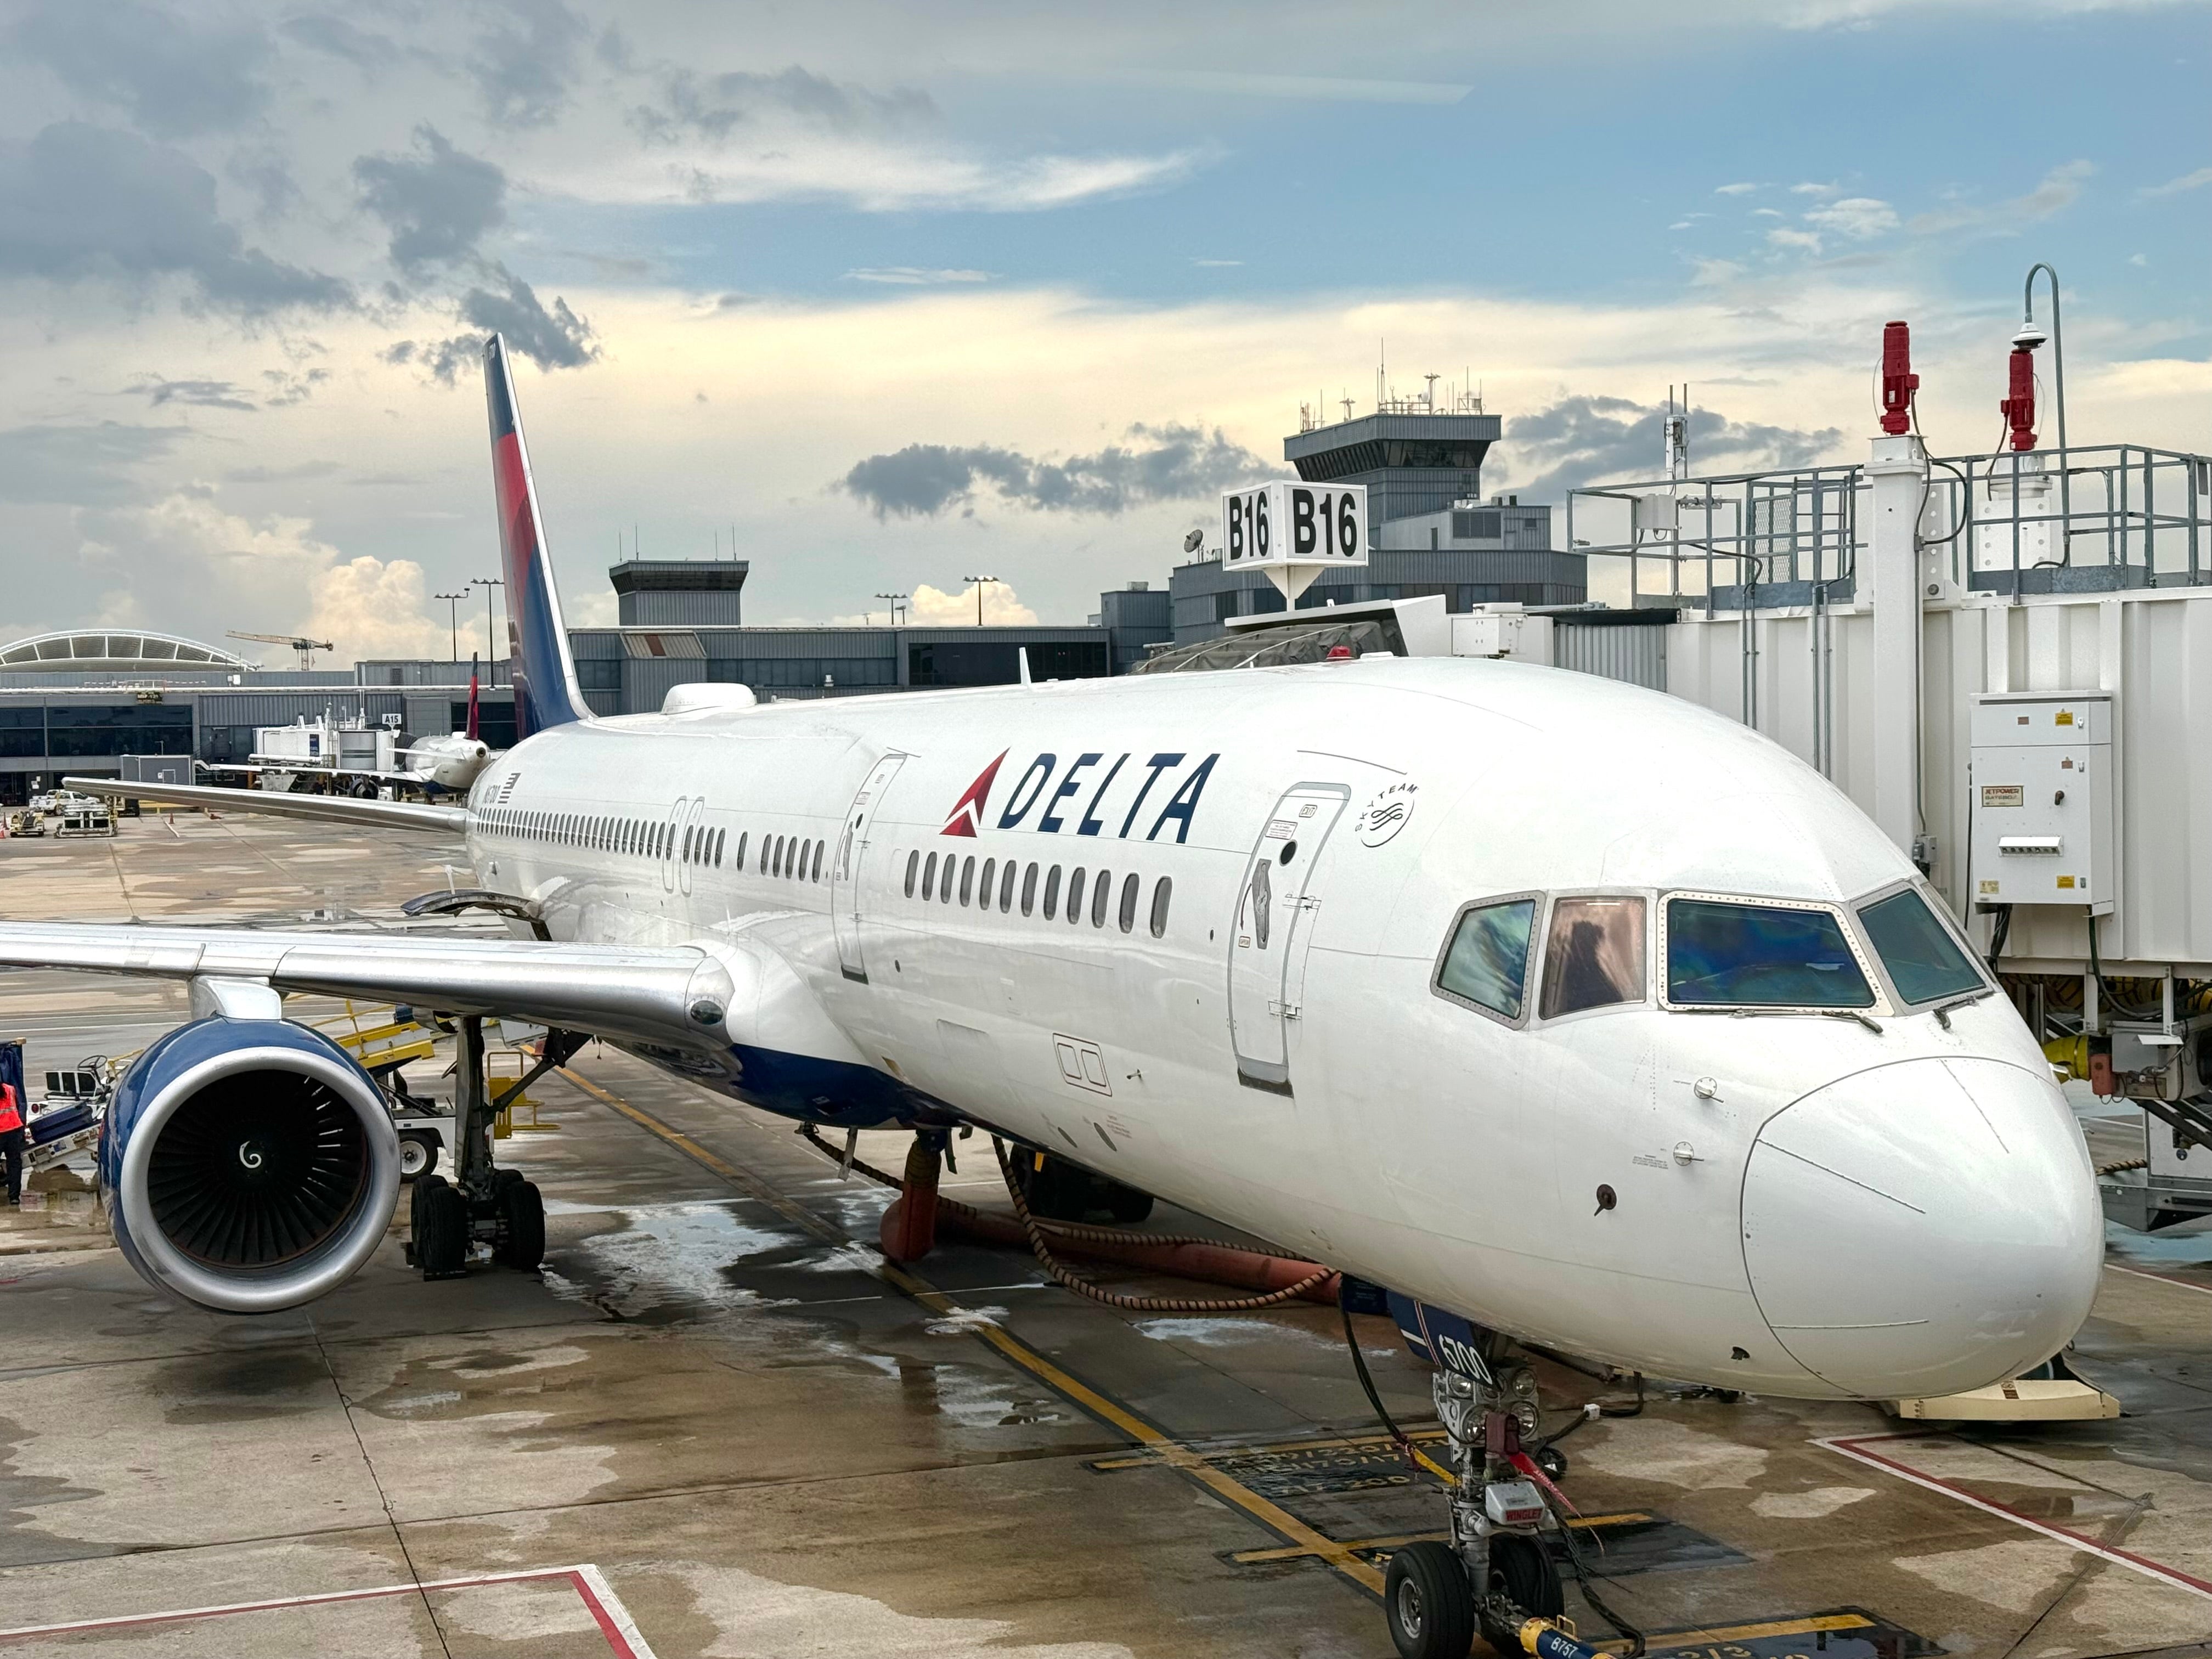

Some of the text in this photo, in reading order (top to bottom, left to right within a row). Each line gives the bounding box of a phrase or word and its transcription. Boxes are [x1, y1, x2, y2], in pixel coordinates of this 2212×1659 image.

[1229, 490, 1269, 561] B16
[1293, 488, 1357, 557] B16
[385, 715, 399, 724] A15
[996, 753, 1221, 844] DELTA
[1438, 1334, 1493, 1385] 6700
[1506, 1509, 1541, 1521] WINGLET
[1550, 1637, 1579, 1658] B757
